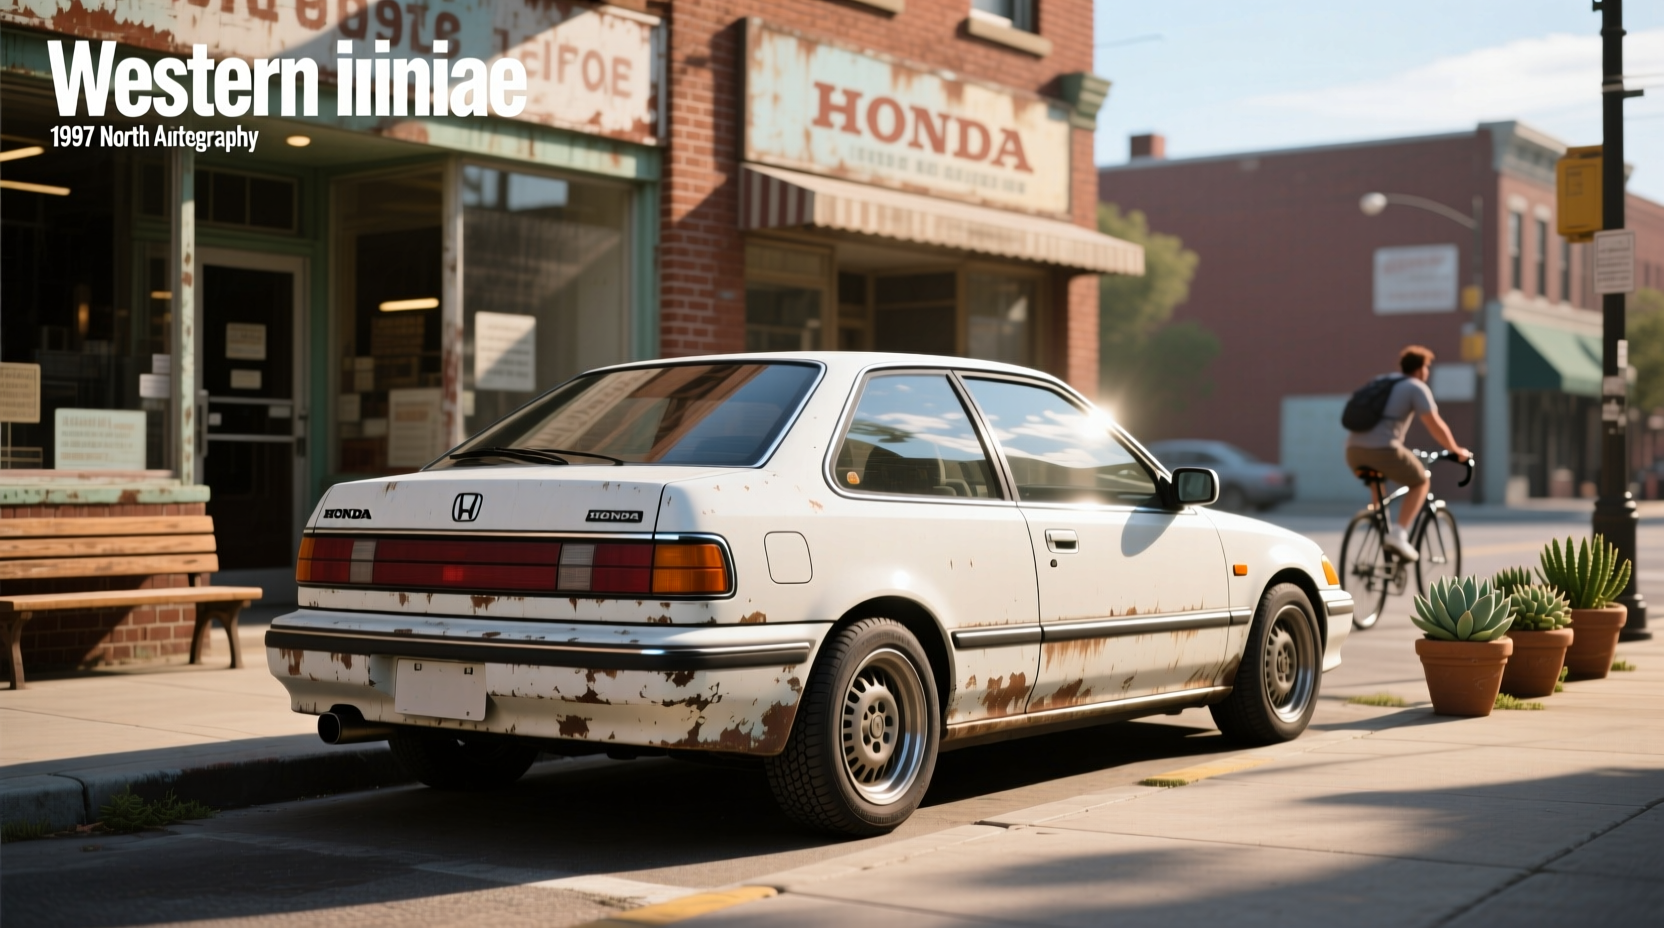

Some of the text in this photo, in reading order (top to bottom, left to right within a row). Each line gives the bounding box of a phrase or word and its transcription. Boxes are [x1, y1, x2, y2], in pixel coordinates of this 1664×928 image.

[812, 81, 1034, 174] HONDA
[323, 508, 372, 520] HONDA
[588, 511, 640, 521] HONDA
